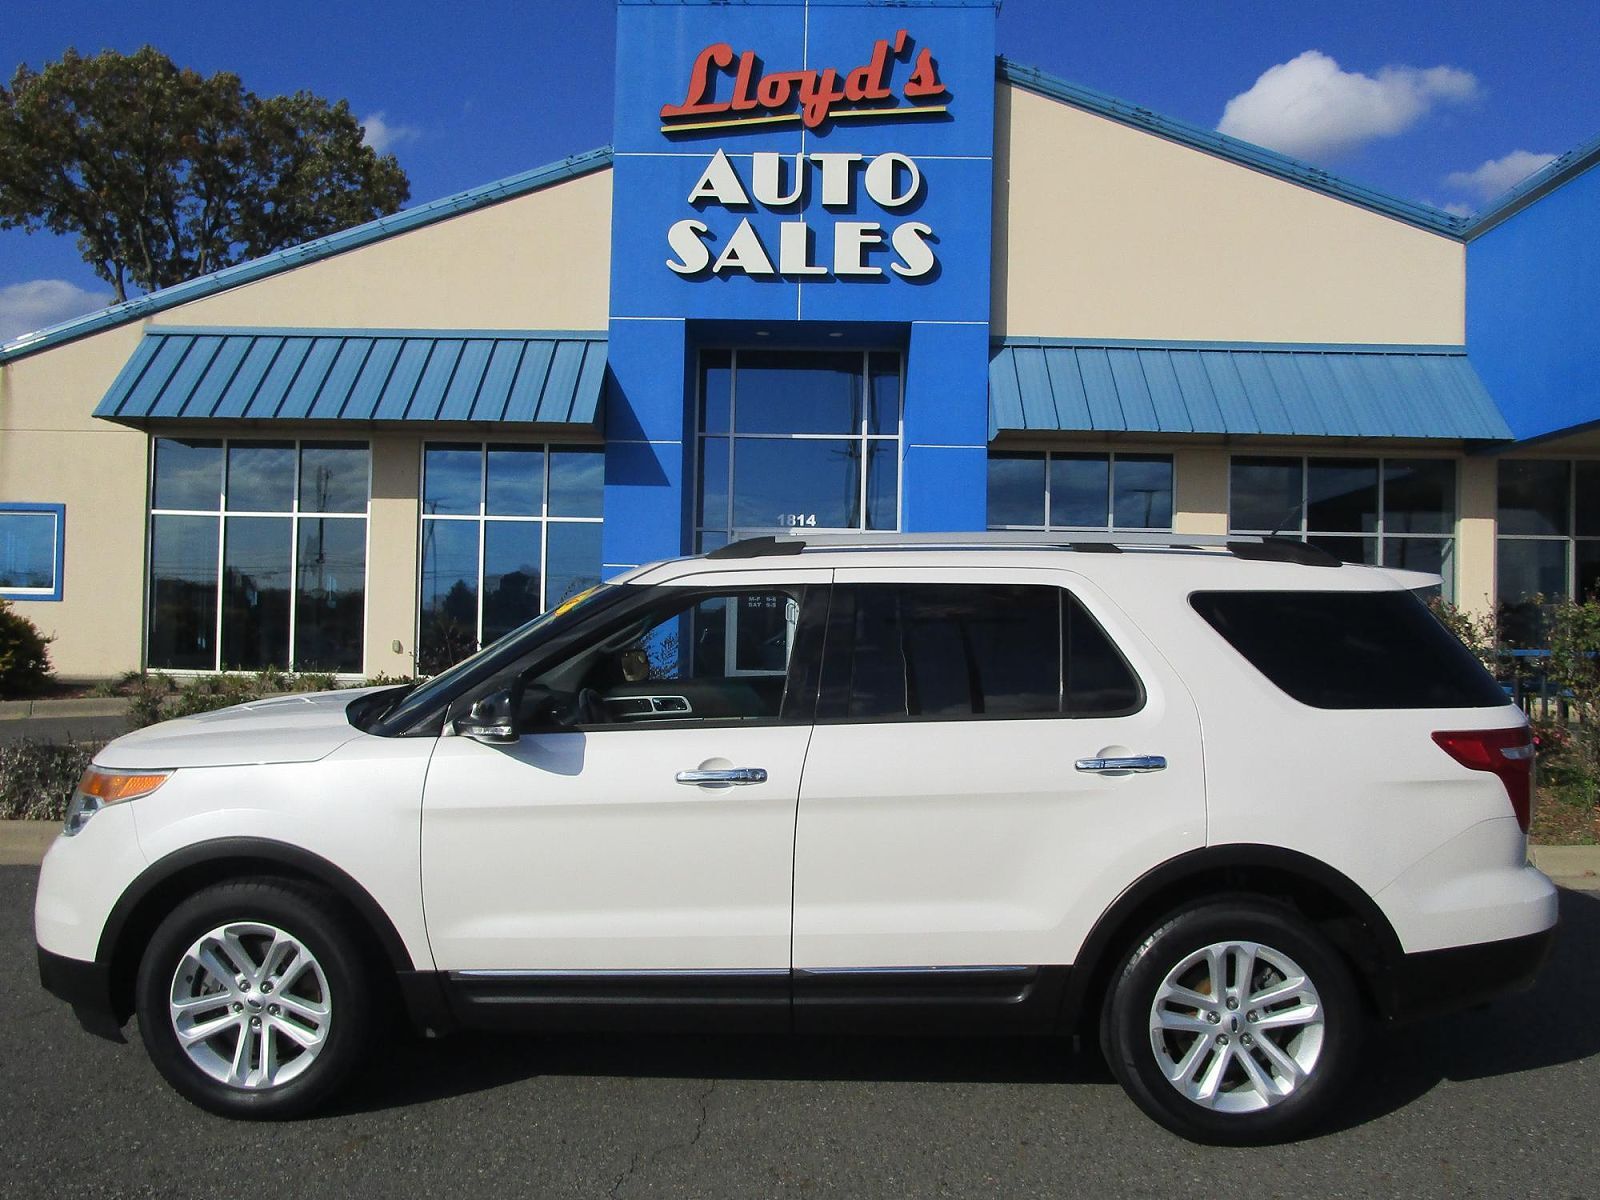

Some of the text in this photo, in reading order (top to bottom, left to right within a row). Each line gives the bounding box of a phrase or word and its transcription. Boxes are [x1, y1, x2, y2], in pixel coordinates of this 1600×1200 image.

[660, 30, 946, 128] Lloyd's
[687, 147, 920, 207] AUTO
[666, 217, 935, 277] SALES
[777, 514, 817, 527] 1814
